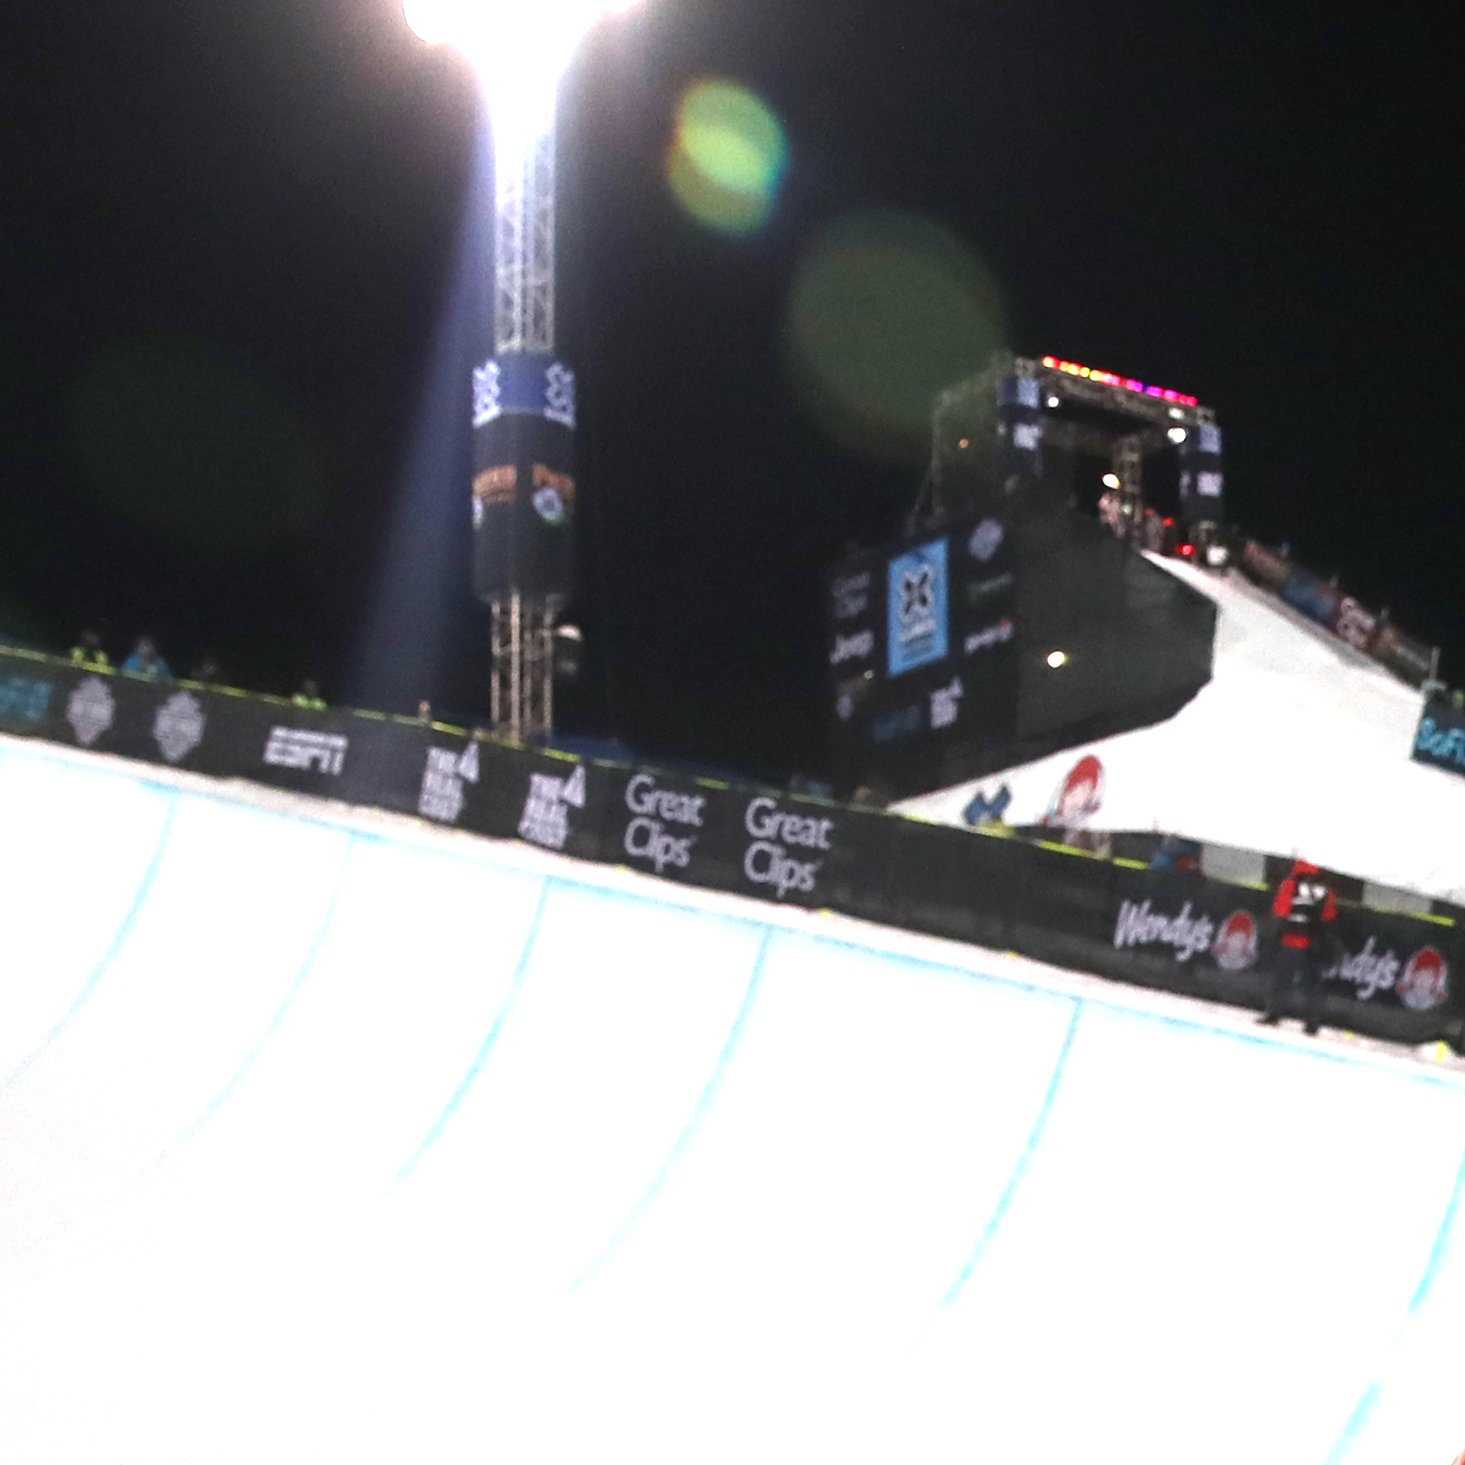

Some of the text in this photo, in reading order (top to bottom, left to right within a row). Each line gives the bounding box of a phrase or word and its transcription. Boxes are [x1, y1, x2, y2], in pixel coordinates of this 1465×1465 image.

[625, 774, 704, 826] Great
[744, 798, 834, 850] Great
[624, 818, 692, 873] Clips
[744, 840, 819, 899] Clips
